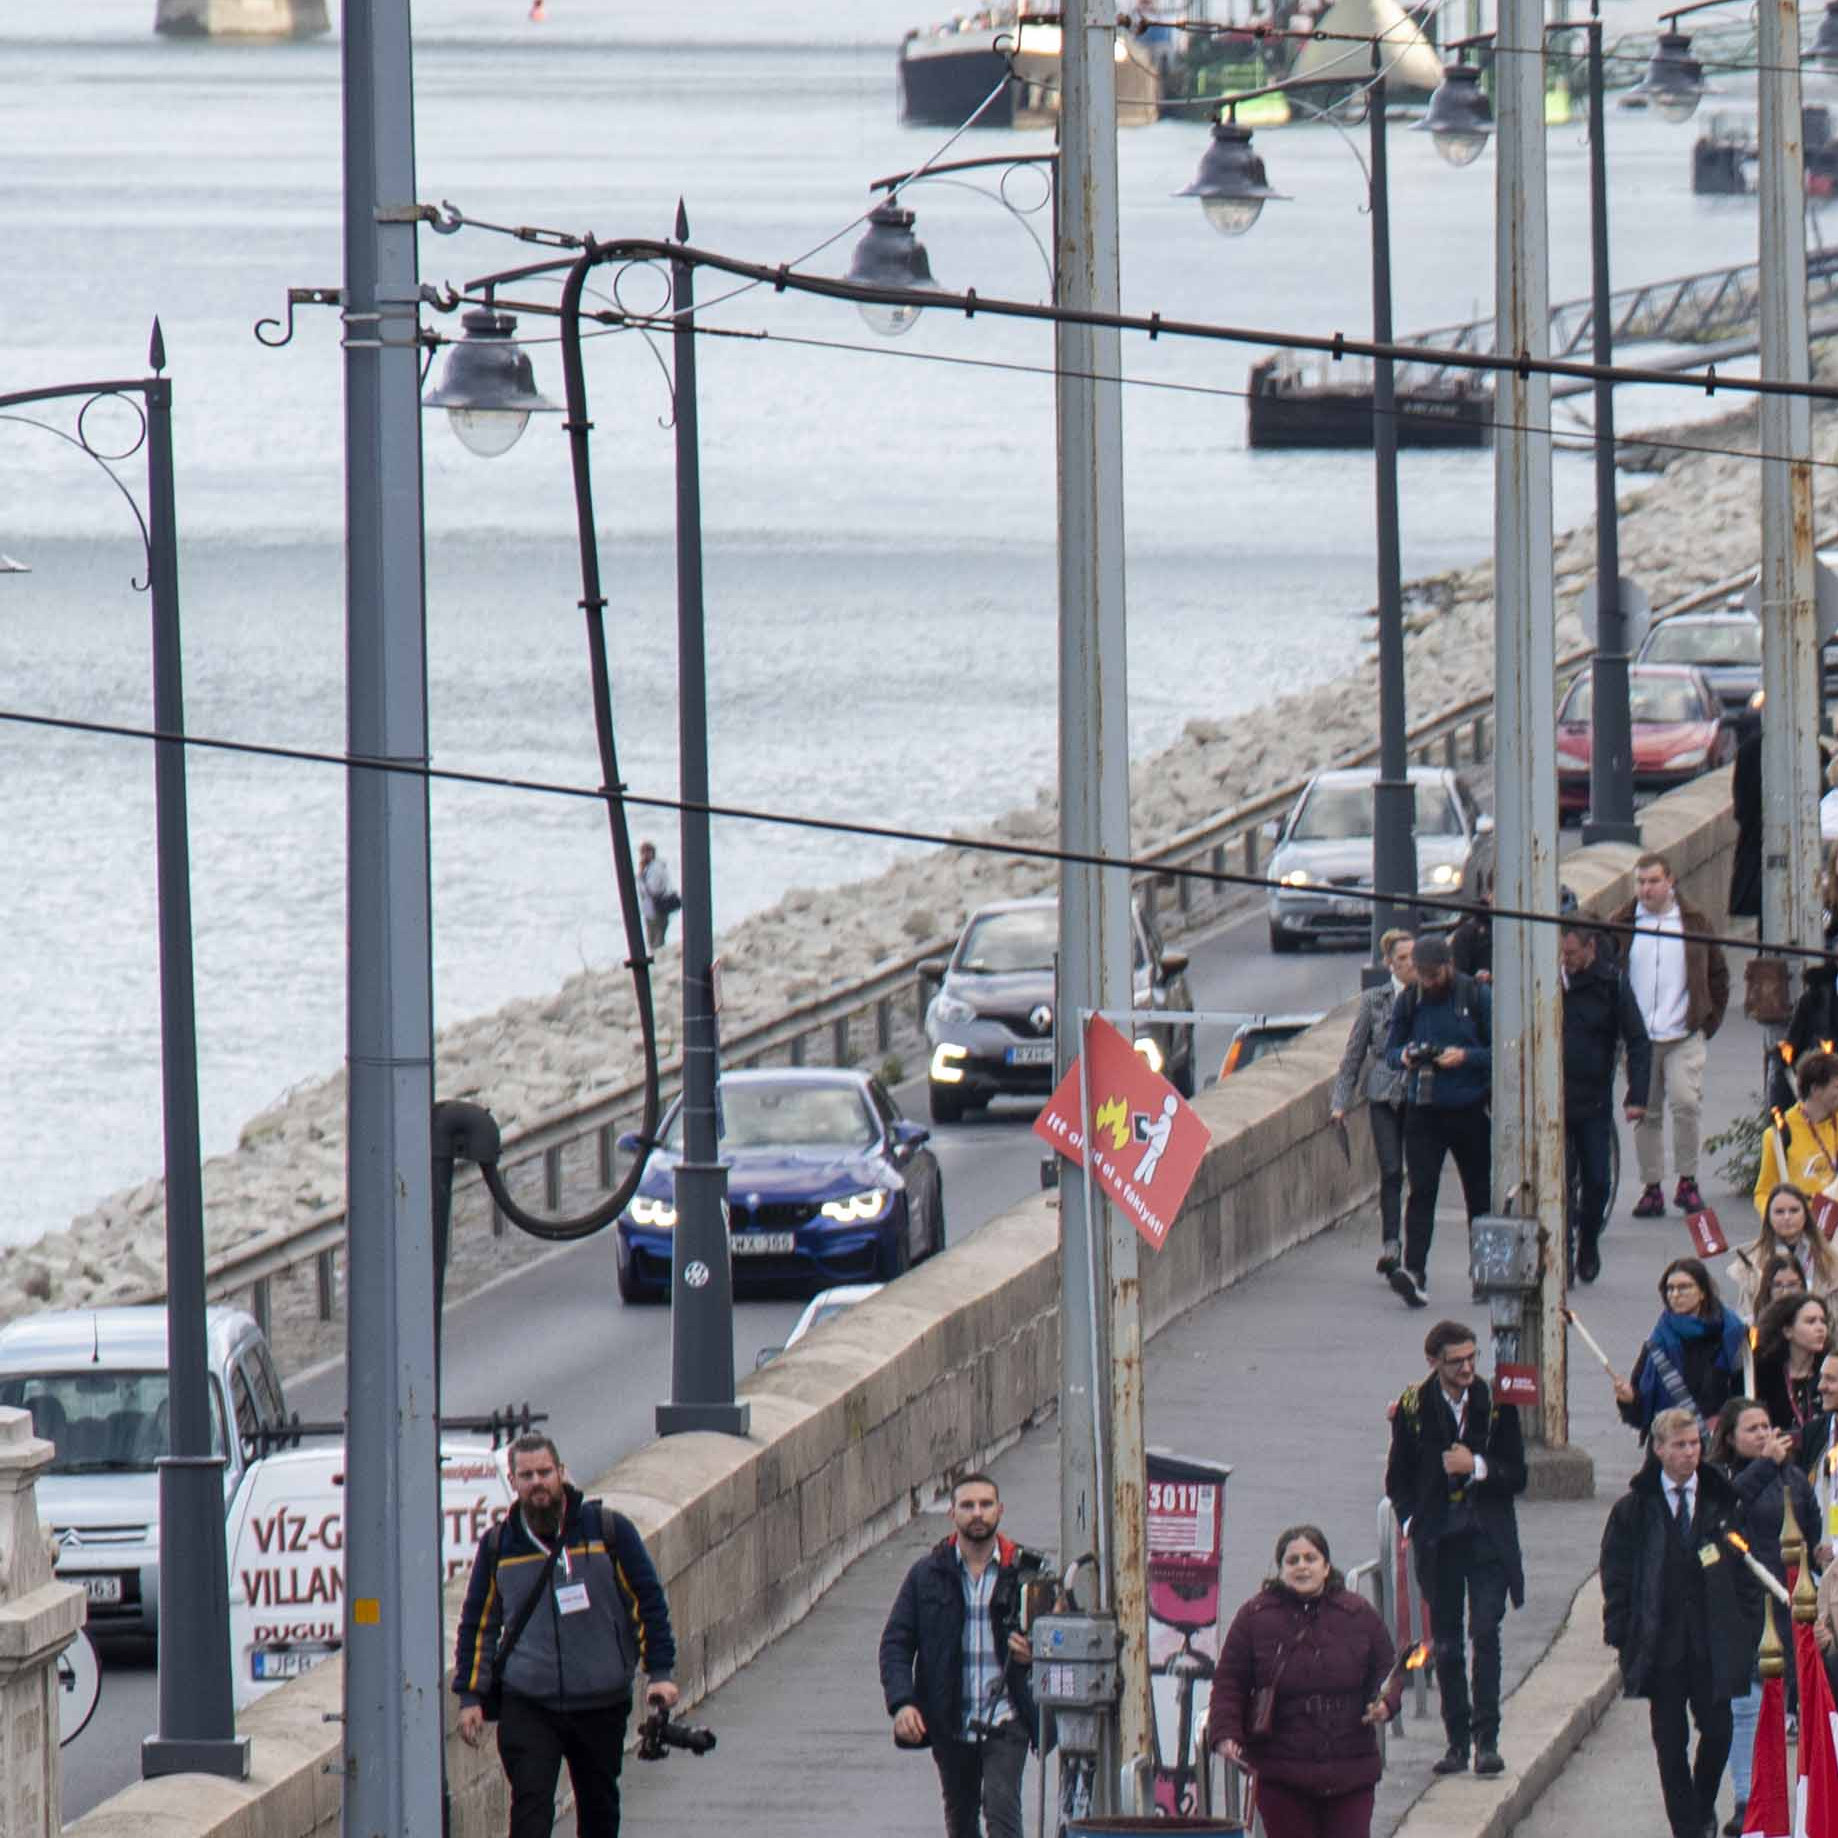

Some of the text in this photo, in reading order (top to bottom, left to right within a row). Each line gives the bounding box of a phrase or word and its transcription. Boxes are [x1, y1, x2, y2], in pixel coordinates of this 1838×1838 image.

[1148, 1483, 1197, 1511] 3011
[251, 1506, 343, 1555] VÍZ-G
[240, 1564, 344, 1606] VILLAN
[253, 1621, 336, 1642] DUGUL
